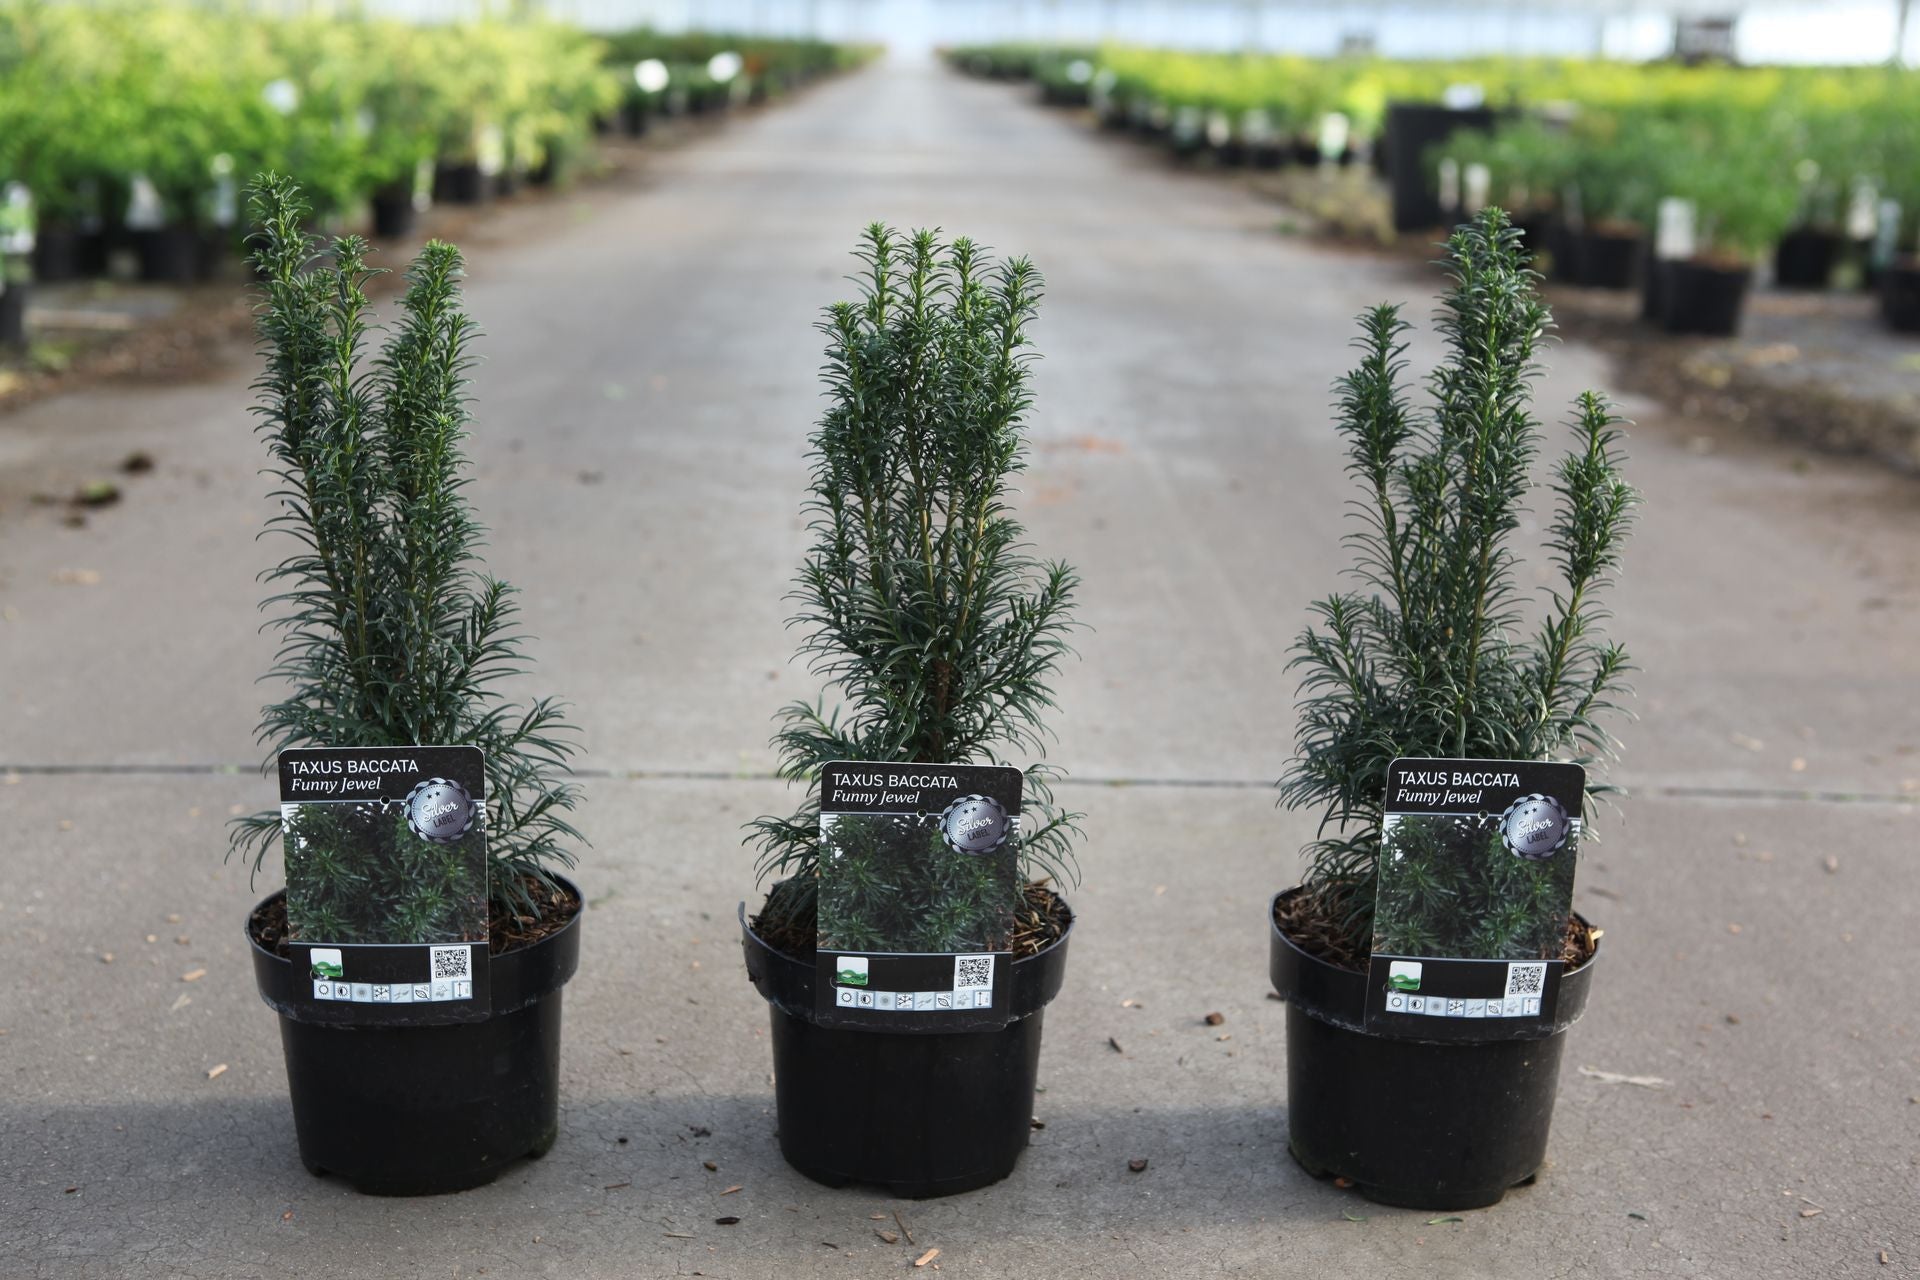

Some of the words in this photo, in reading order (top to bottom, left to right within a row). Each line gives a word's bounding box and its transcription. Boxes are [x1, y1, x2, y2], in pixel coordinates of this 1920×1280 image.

[289, 760, 342, 775] TAXUS
[347, 759, 419, 773] BACCATA
[291, 778, 338, 793] Funny
[340, 777, 381, 793] Jewel
[832, 773, 884, 787] TAXUS
[888, 774, 958, 789] BACCATA
[1398, 771, 1448, 786] TAXUS
[1452, 772, 1520, 788] BACCATA
[831, 789, 878, 805] Funny
[878, 790, 920, 806] Jewel
[1396, 789, 1441, 806] Funny
[1441, 790, 1483, 806] Jewel
[421, 801, 459, 822] Silver
[433, 814, 456, 828] LABEL
[956, 814, 994, 836] Silver
[1516, 818, 1554, 838] Silver
[967, 829, 990, 841] LABEL
[1526, 831, 1549, 844] LABEL
